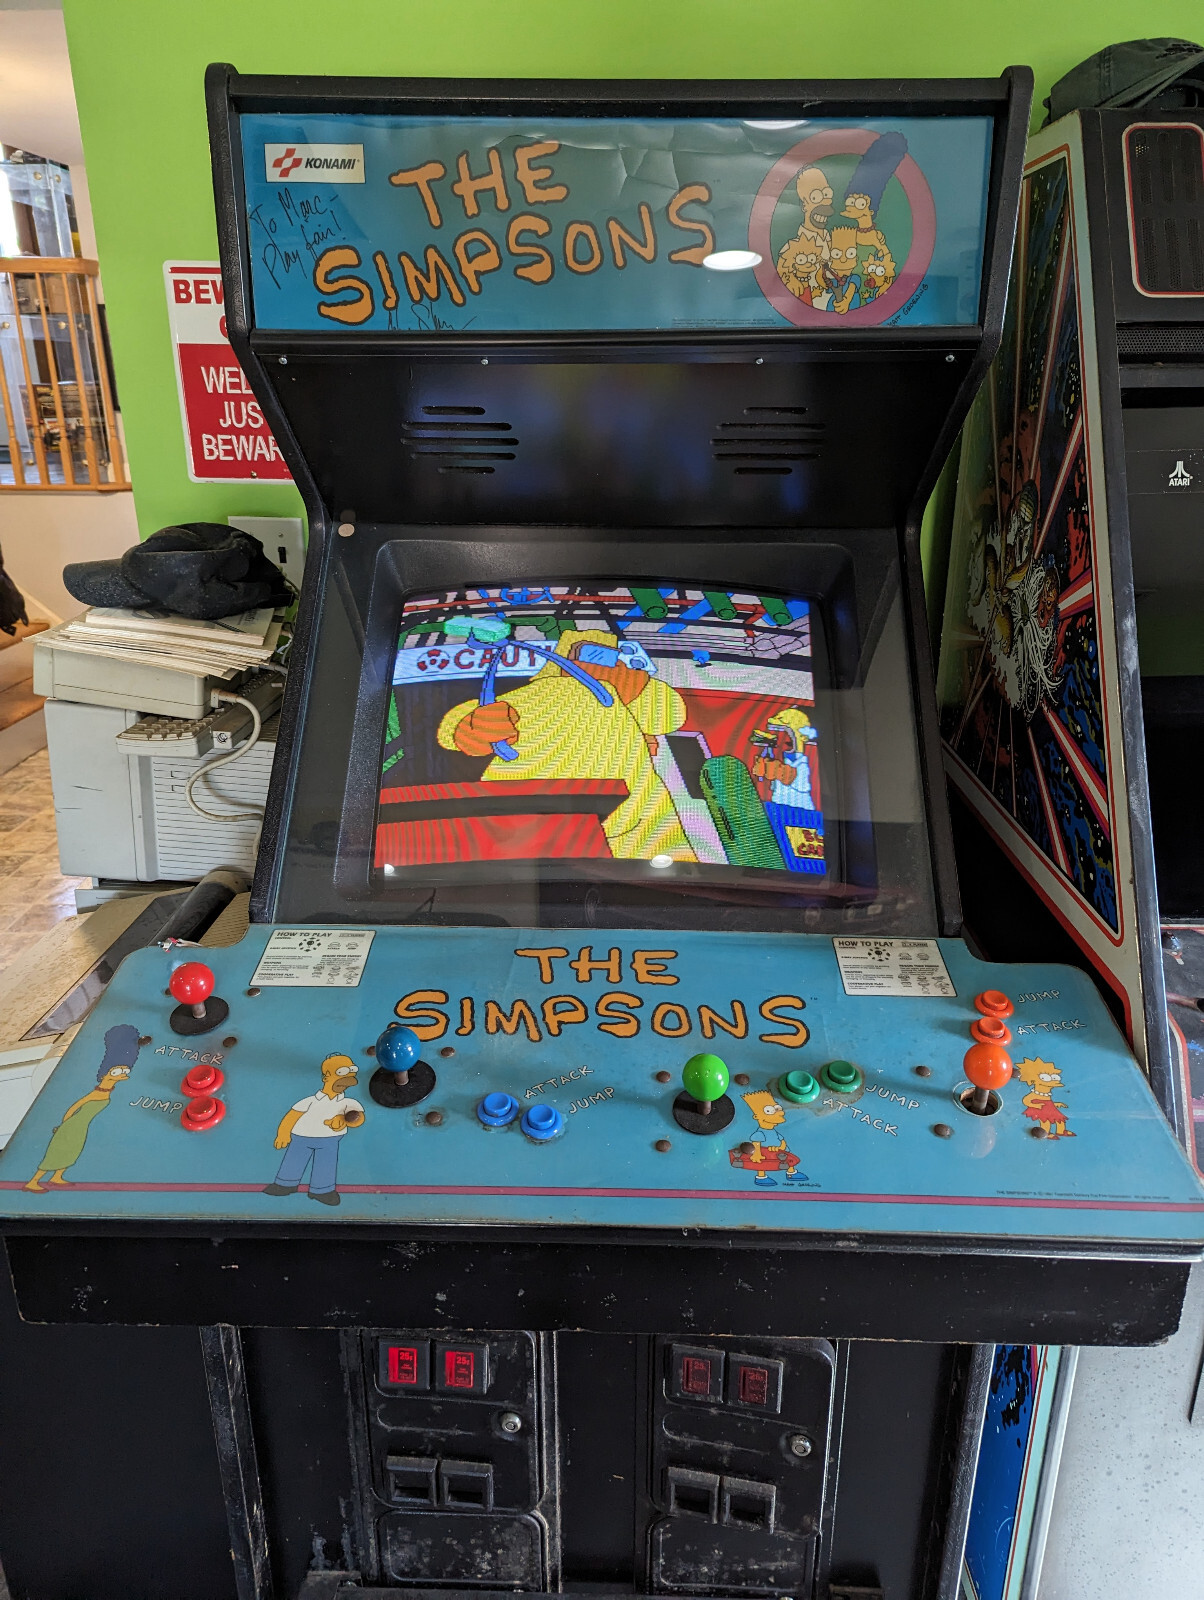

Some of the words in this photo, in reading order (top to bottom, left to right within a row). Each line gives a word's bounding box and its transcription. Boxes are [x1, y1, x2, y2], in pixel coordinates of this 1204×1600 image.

[305, 157, 356, 170] KONAMI
[389, 140, 569, 229] THE
[313, 180, 716, 326] SIMPSONS
[201, 366, 254, 394] WEL
[219, 401, 264, 428] JUS
[202, 434, 286, 462] BEWAR
[1169, 478, 1190, 487] ATARI
[454, 645, 551, 670] CAUT
[514, 945, 681, 986] THE
[1018, 989, 1060, 1003] JUMP
[387, 989, 811, 1049] SIMPSONS
[1017, 1019, 1087, 1035] ATTACK
[154, 1045, 224, 1065] ATTACK
[524, 1065, 594, 1099] ATTACK
[129, 1096, 184, 1114] JUMP
[569, 1087, 615, 1114] JUMP
[865, 1084, 920, 1110] JUMP
[822, 1098, 898, 1137] ATTACK
